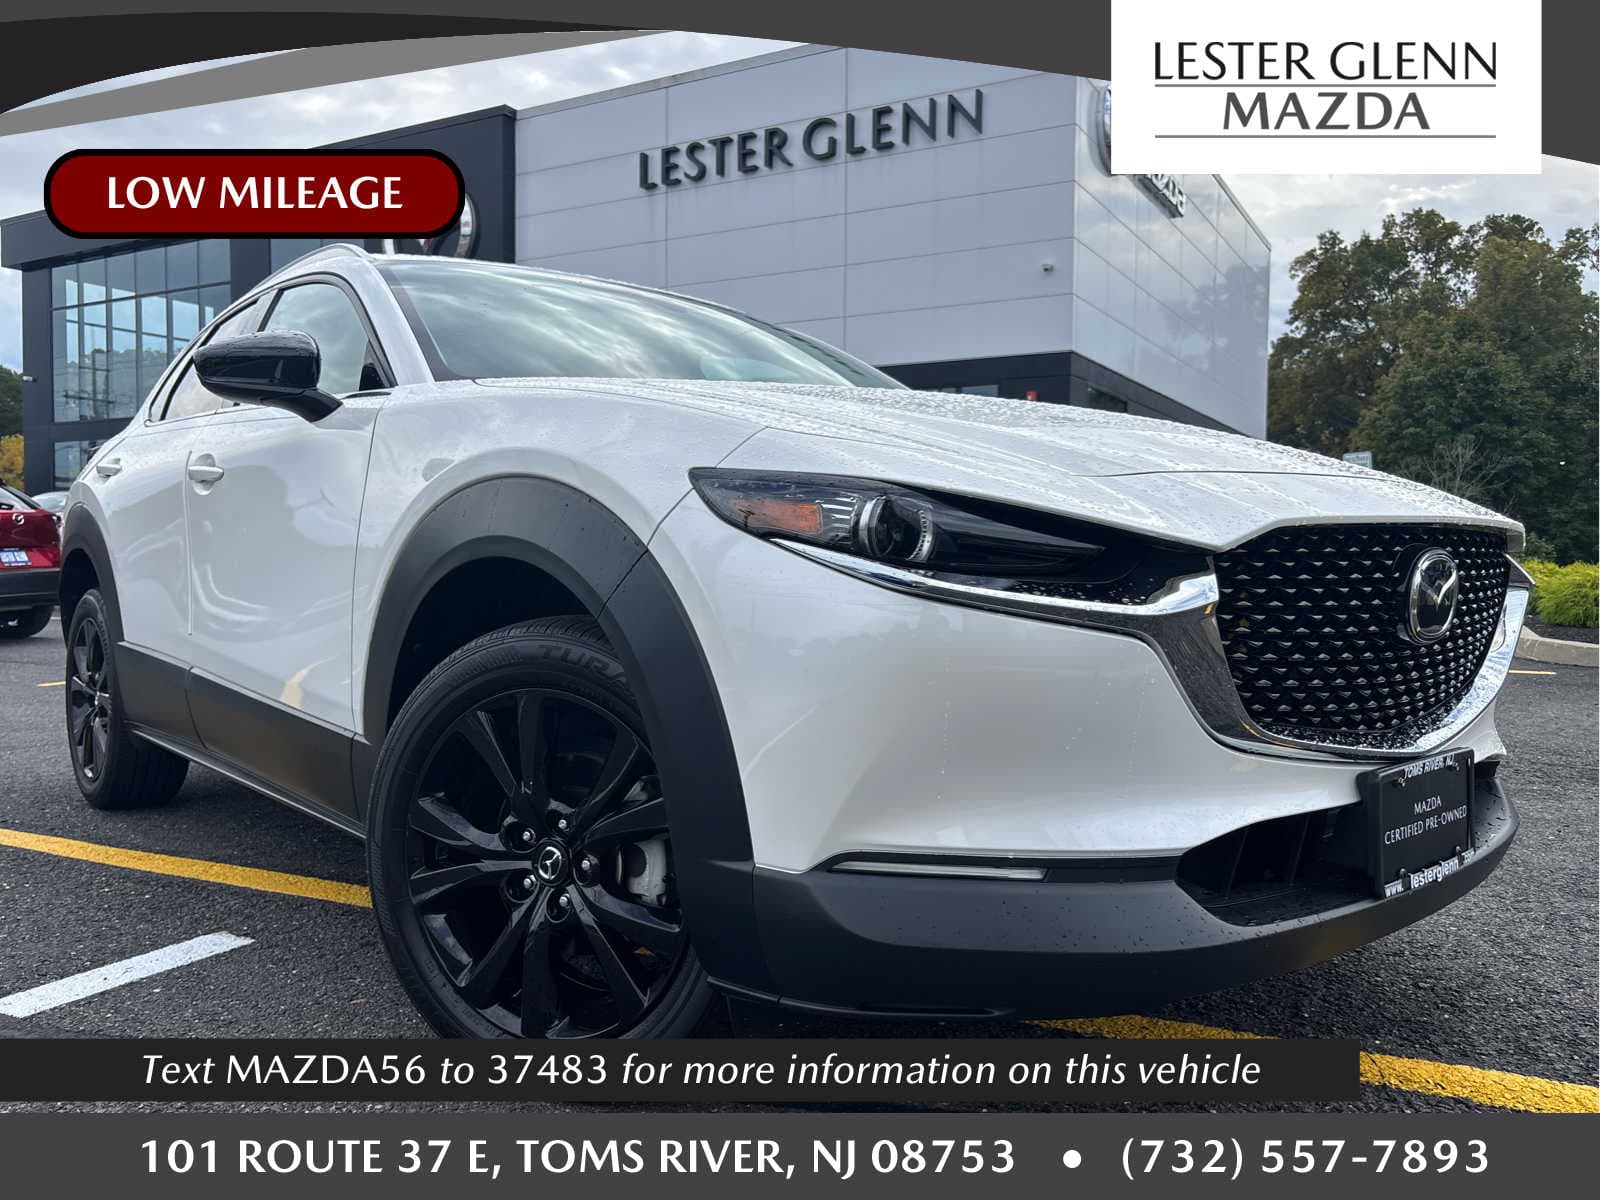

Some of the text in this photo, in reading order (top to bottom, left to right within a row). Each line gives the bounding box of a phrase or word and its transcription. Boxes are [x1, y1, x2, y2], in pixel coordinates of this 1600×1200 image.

[639, 88, 983, 190] LESTER GLENN
[1403, 762, 1423, 779] TOMS
[1414, 795, 1442, 815] MAZDA
[1384, 805, 1467, 845] CERTIFIED PRE-OWNED
